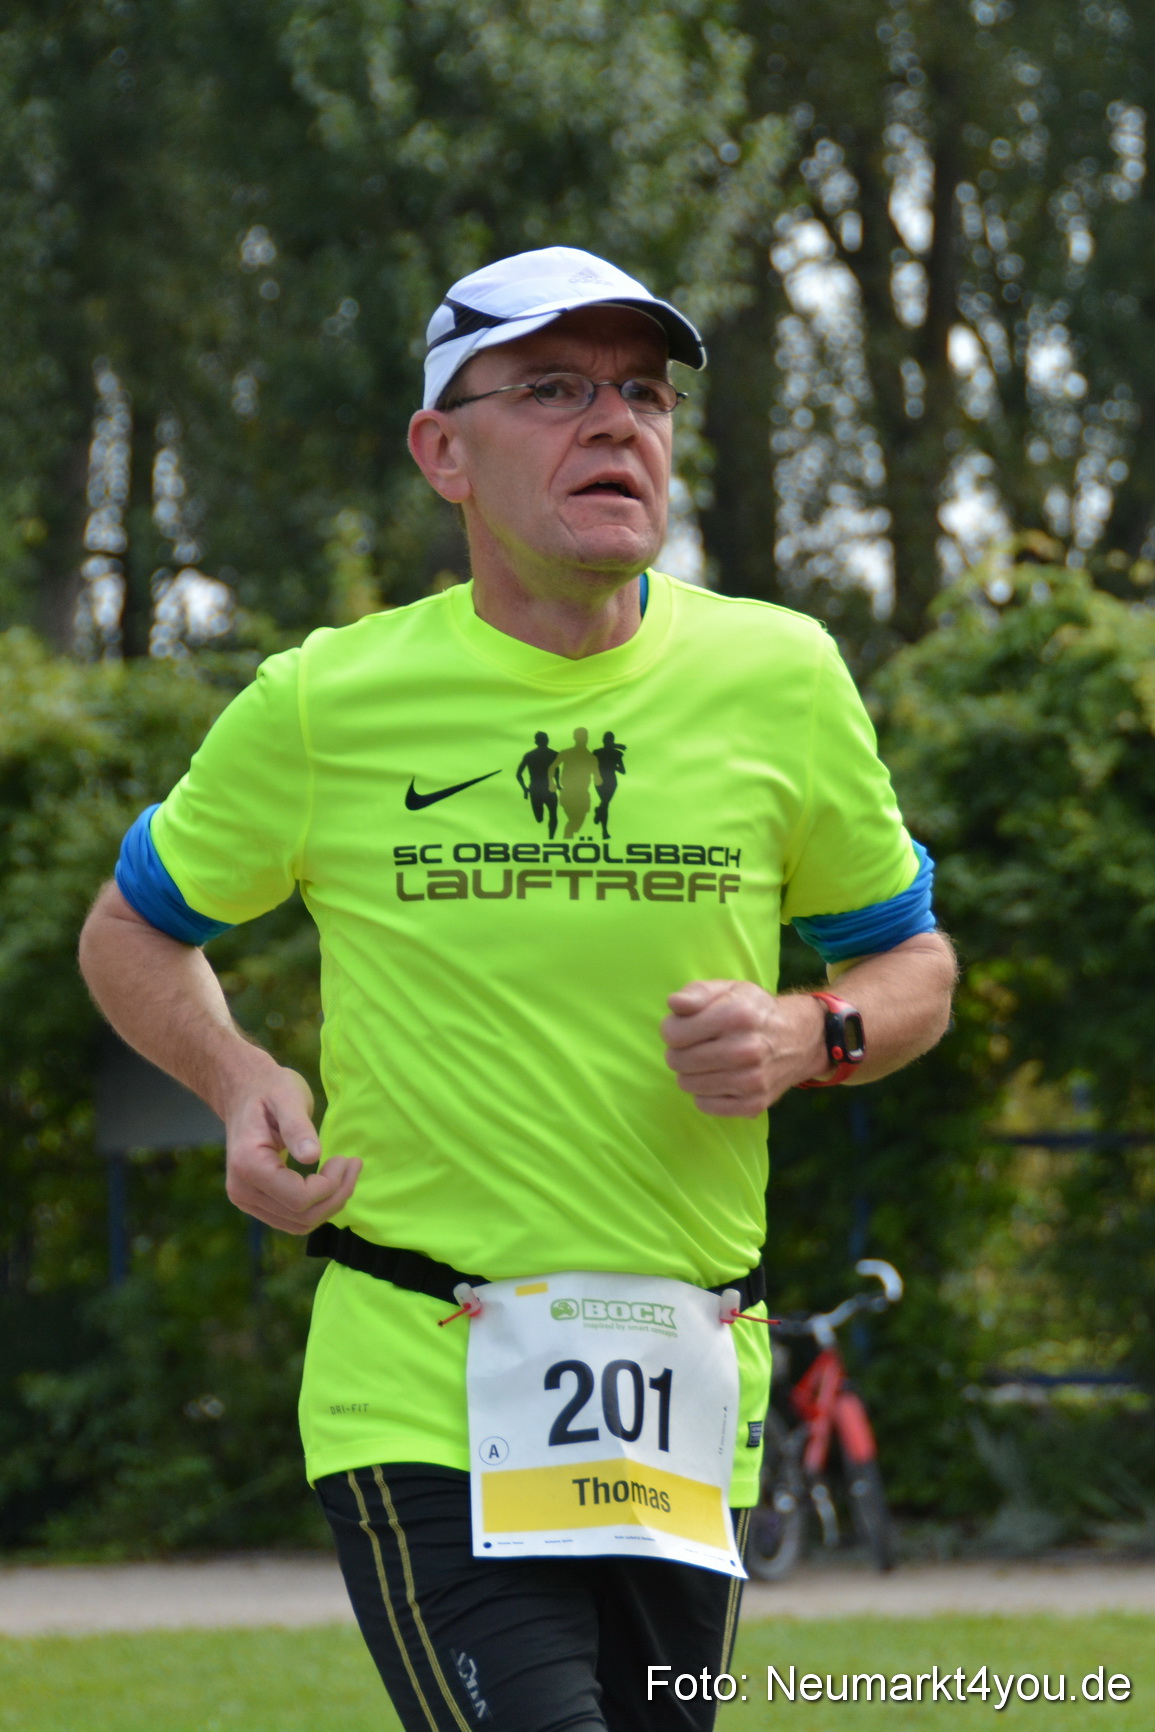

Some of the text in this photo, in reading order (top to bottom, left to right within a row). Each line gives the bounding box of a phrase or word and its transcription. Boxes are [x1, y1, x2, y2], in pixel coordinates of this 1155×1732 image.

[393, 843, 443, 866] SC
[581, 1298, 678, 1330] BOCK
[329, 1403, 369, 1415] DRI-FIT
[543, 1359, 673, 1453] 201
[488, 1443, 500, 1459] A
[572, 1476, 672, 1513] Thomas
